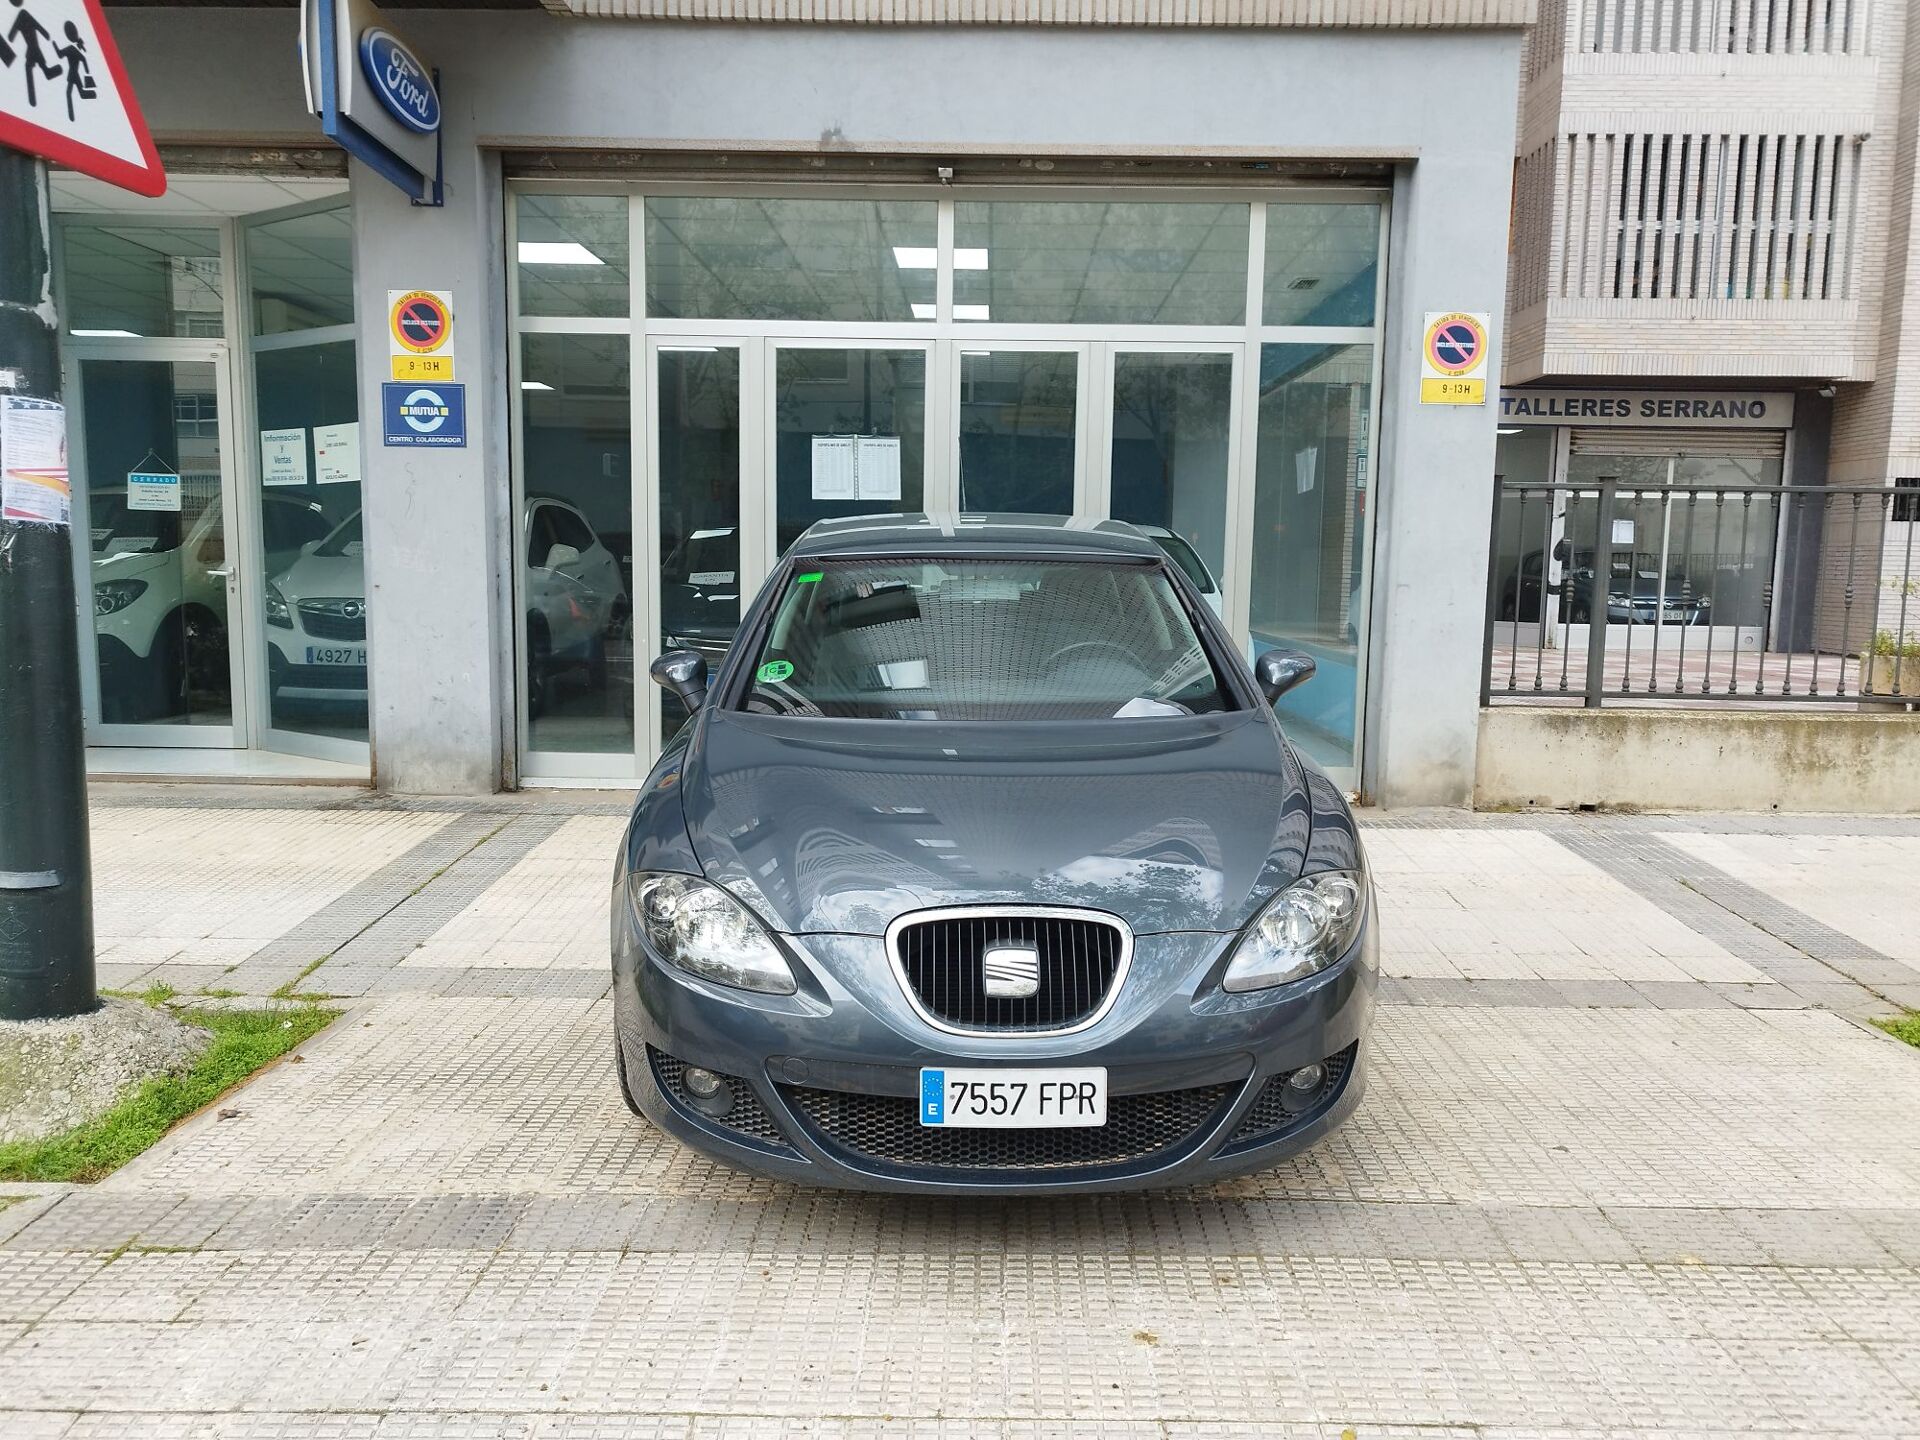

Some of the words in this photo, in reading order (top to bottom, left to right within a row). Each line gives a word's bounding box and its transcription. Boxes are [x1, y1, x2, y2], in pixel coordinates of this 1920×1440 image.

[387, 48, 429, 118] Ford
[409, 406, 440, 416] MUTUA
[1500, 398, 1631, 418] TALLERES
[1639, 400, 1767, 419] SERRANO
[316, 649, 352, 664] 4927
[927, 1103, 938, 1115] E
[950, 1082, 1028, 1115] 7557
[1039, 1082, 1097, 1115] FPR
